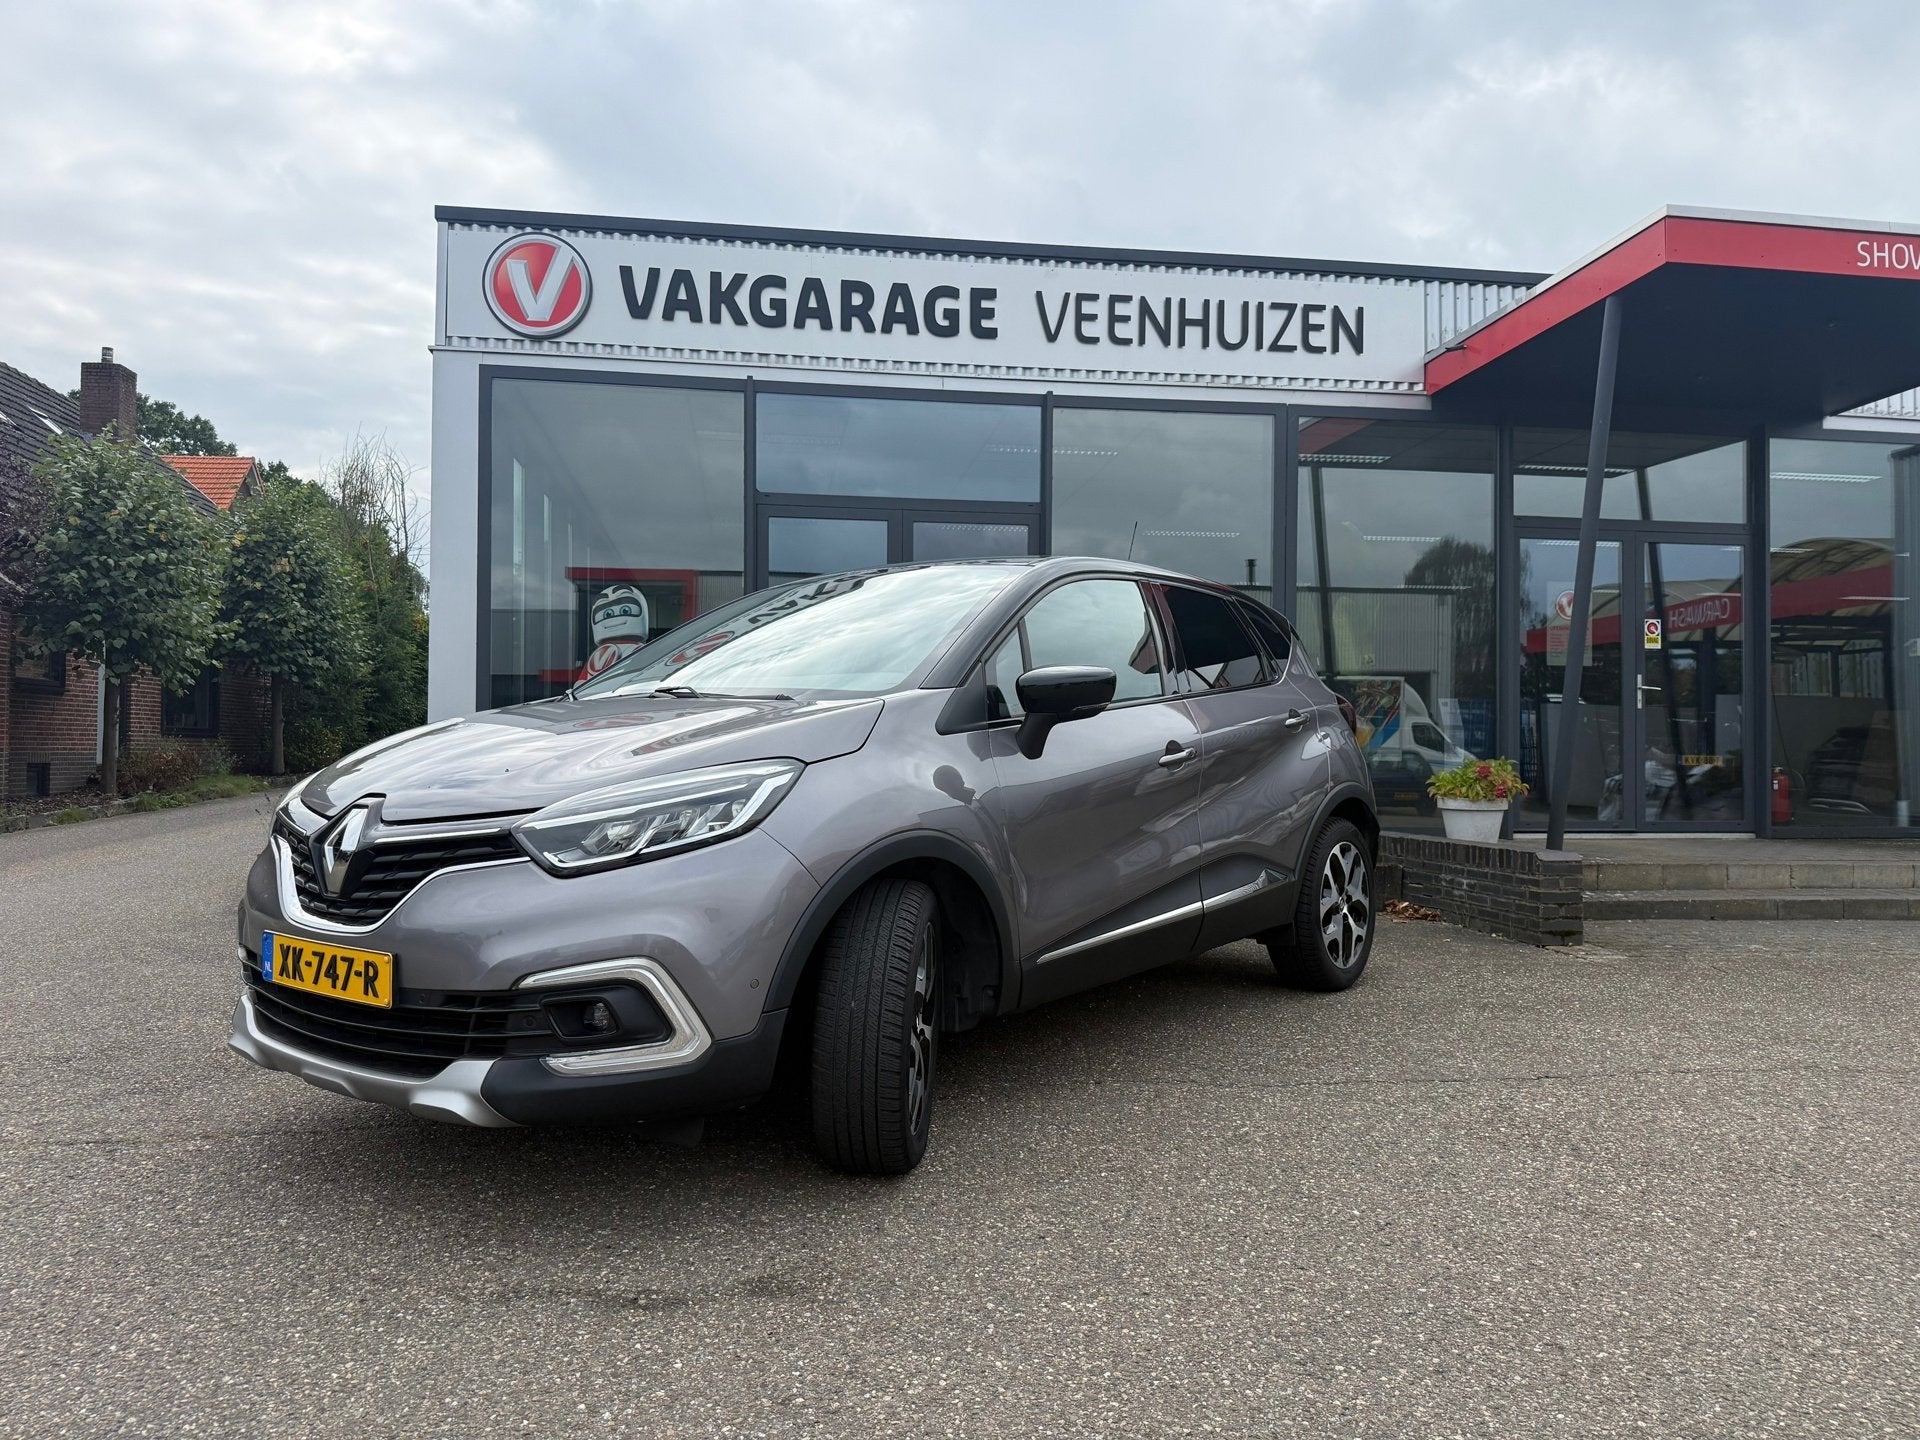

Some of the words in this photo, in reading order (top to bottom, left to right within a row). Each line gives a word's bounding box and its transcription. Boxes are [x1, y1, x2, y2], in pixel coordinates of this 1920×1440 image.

[619, 264, 999, 340] VAKGARAGE
[1035, 290, 1365, 356] VEENHUIZEN
[278, 943, 379, 999] XK-747-R
